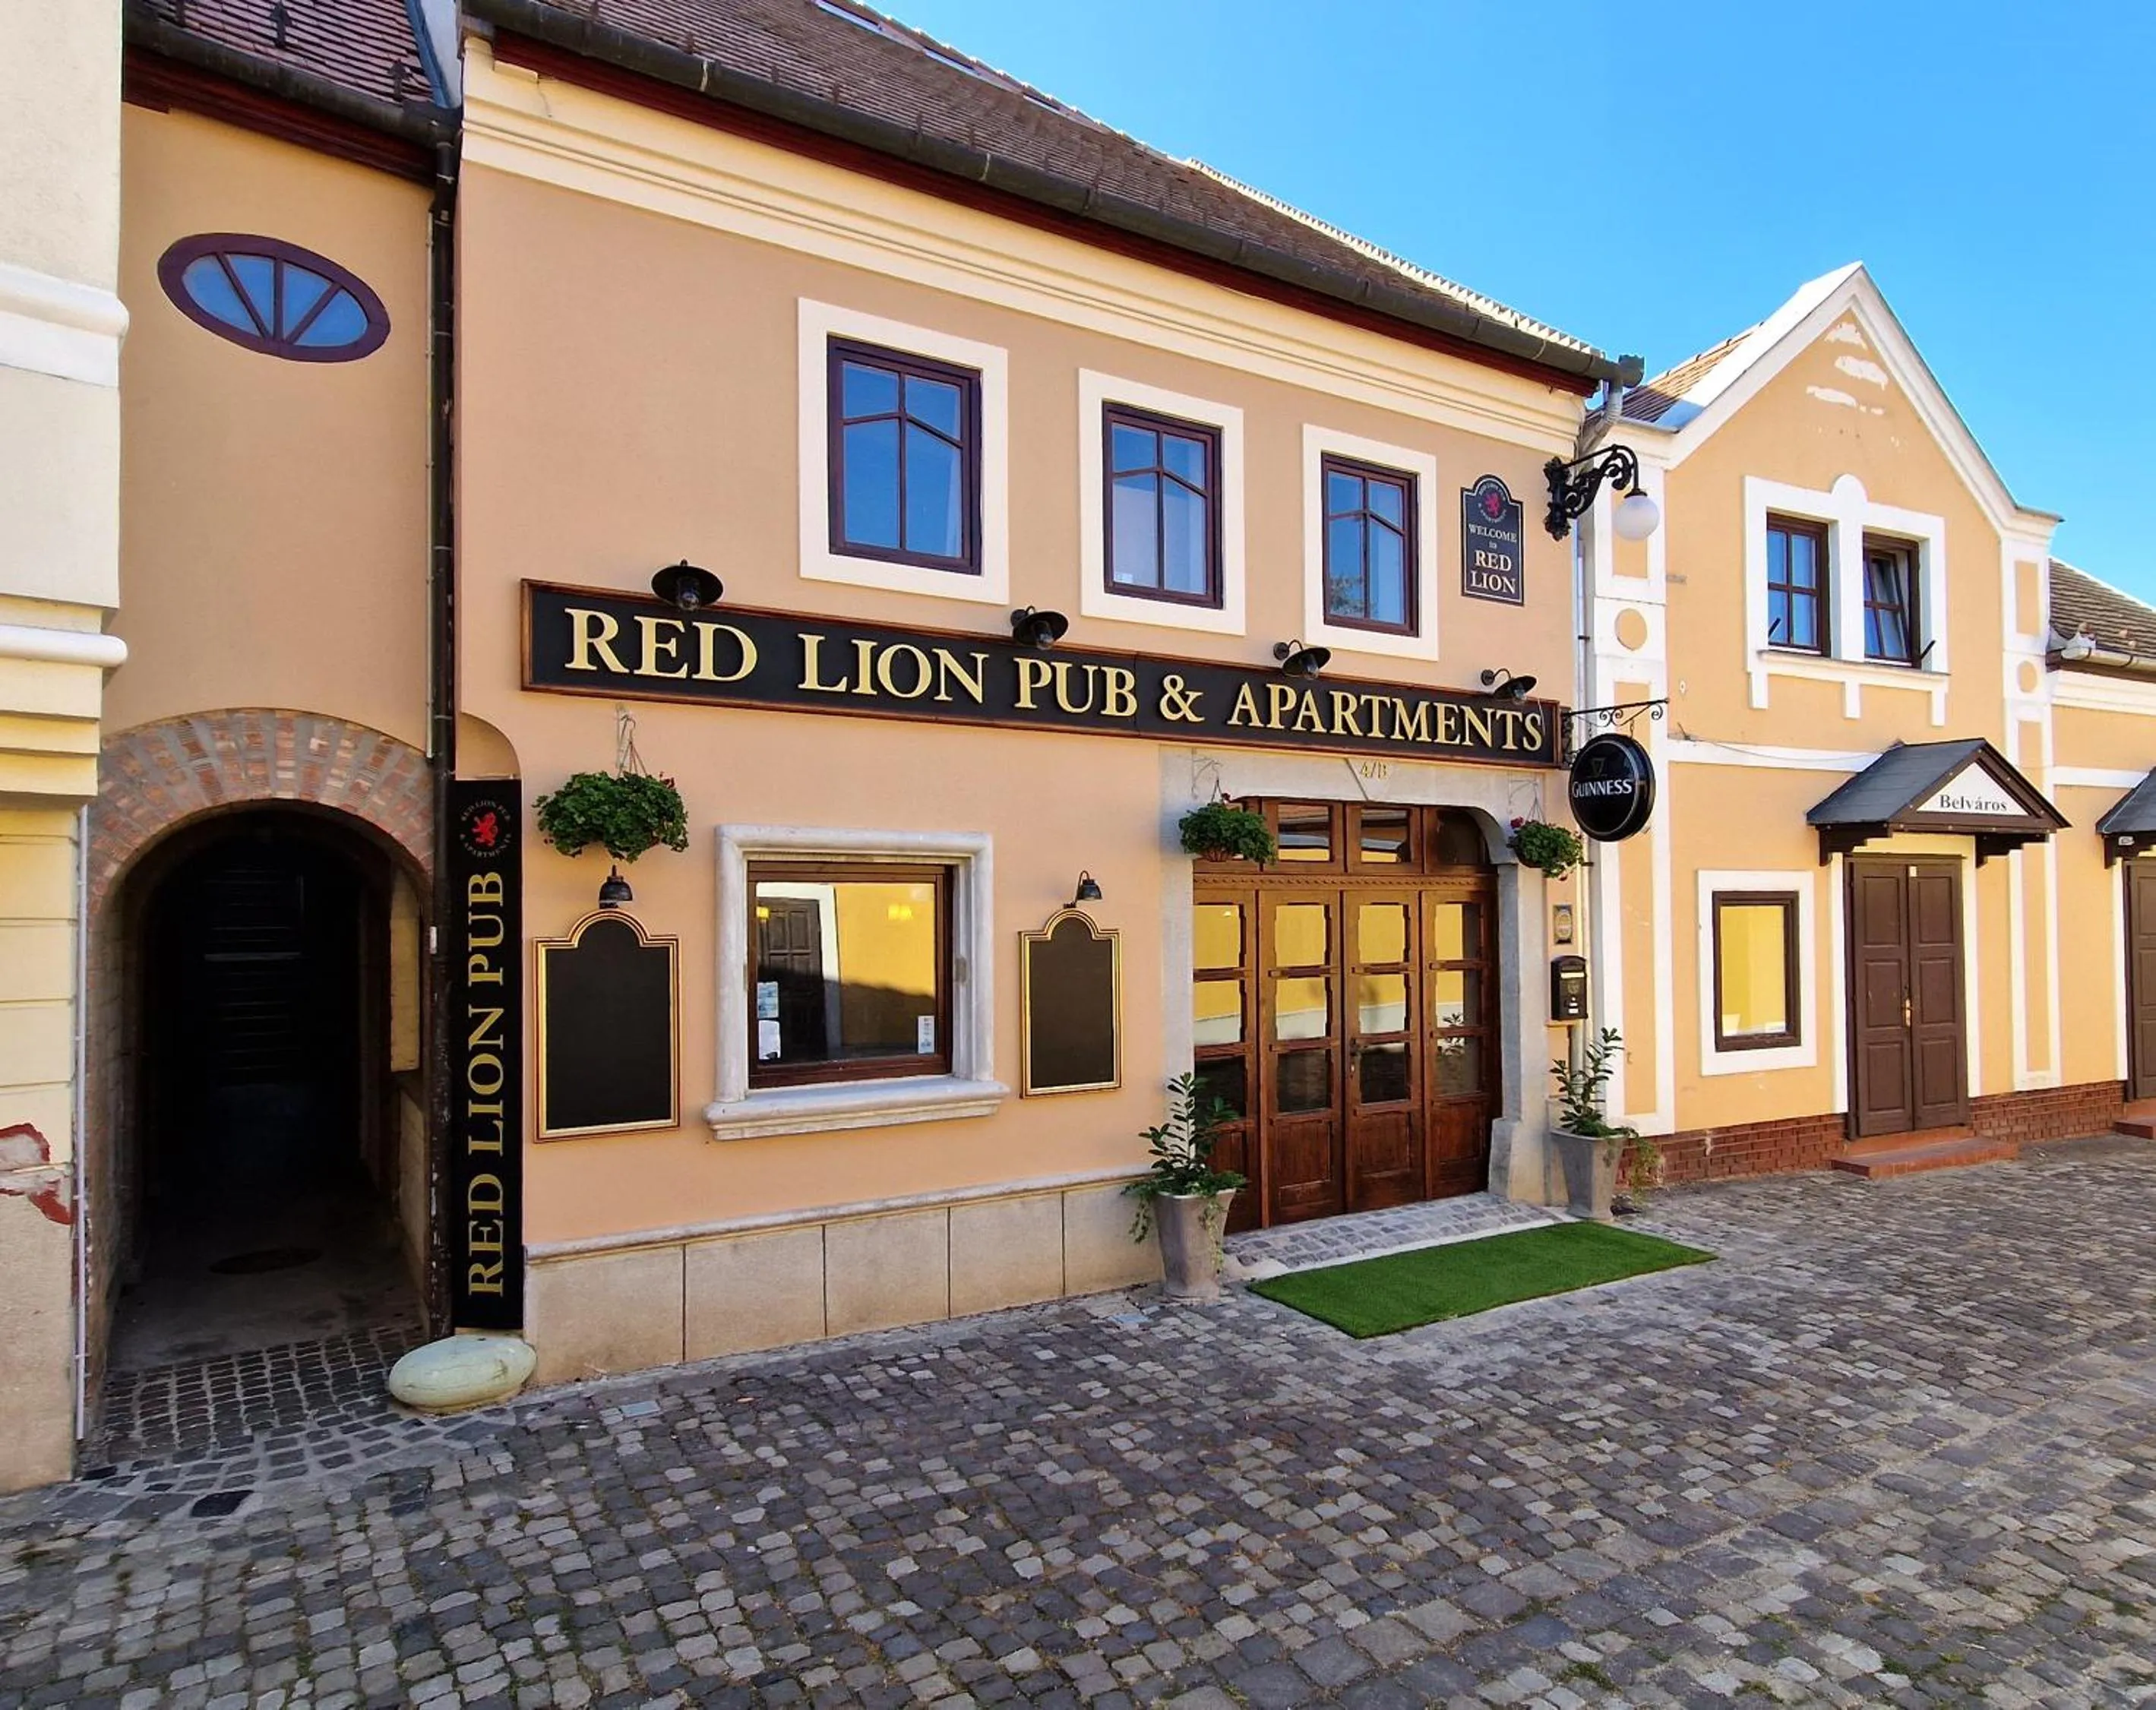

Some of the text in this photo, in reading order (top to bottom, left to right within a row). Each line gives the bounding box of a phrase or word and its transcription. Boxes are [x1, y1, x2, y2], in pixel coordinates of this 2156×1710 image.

[1468, 523, 1517, 542] WELCOME
[1474, 549, 1512, 571] RED
[1470, 571, 1516, 595] LION
[564, 607, 1544, 752] RED LION PUB & APARTMENTS
[1572, 778, 1633, 798] GUINNESS
[1939, 795, 2007, 812] Belváros
[468, 871, 504, 1296] RED LION PUB
